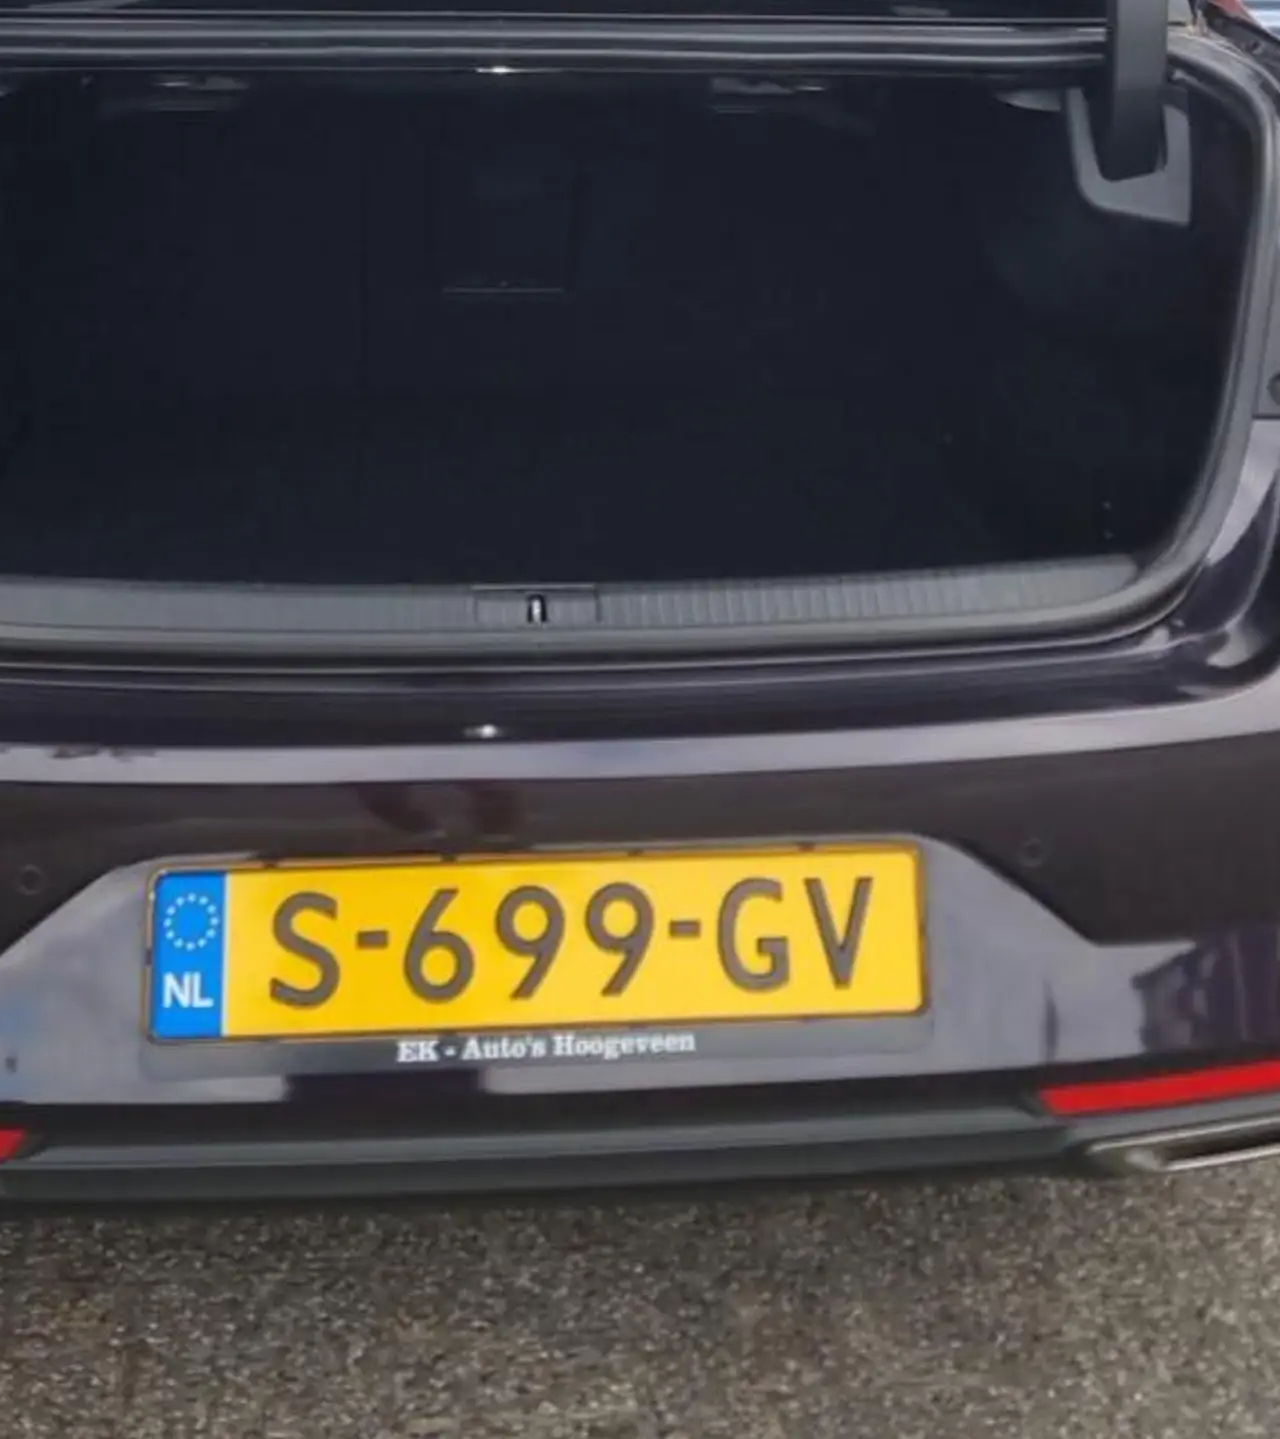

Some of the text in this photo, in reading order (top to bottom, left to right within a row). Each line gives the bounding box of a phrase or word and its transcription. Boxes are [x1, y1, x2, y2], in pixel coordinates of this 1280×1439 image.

[162, 876, 873, 1009] NL S-699-GV
[396, 1041, 440, 1064] EK
[462, 1036, 547, 1061] Auto's
[551, 1032, 697, 1059] Hoogeveen
